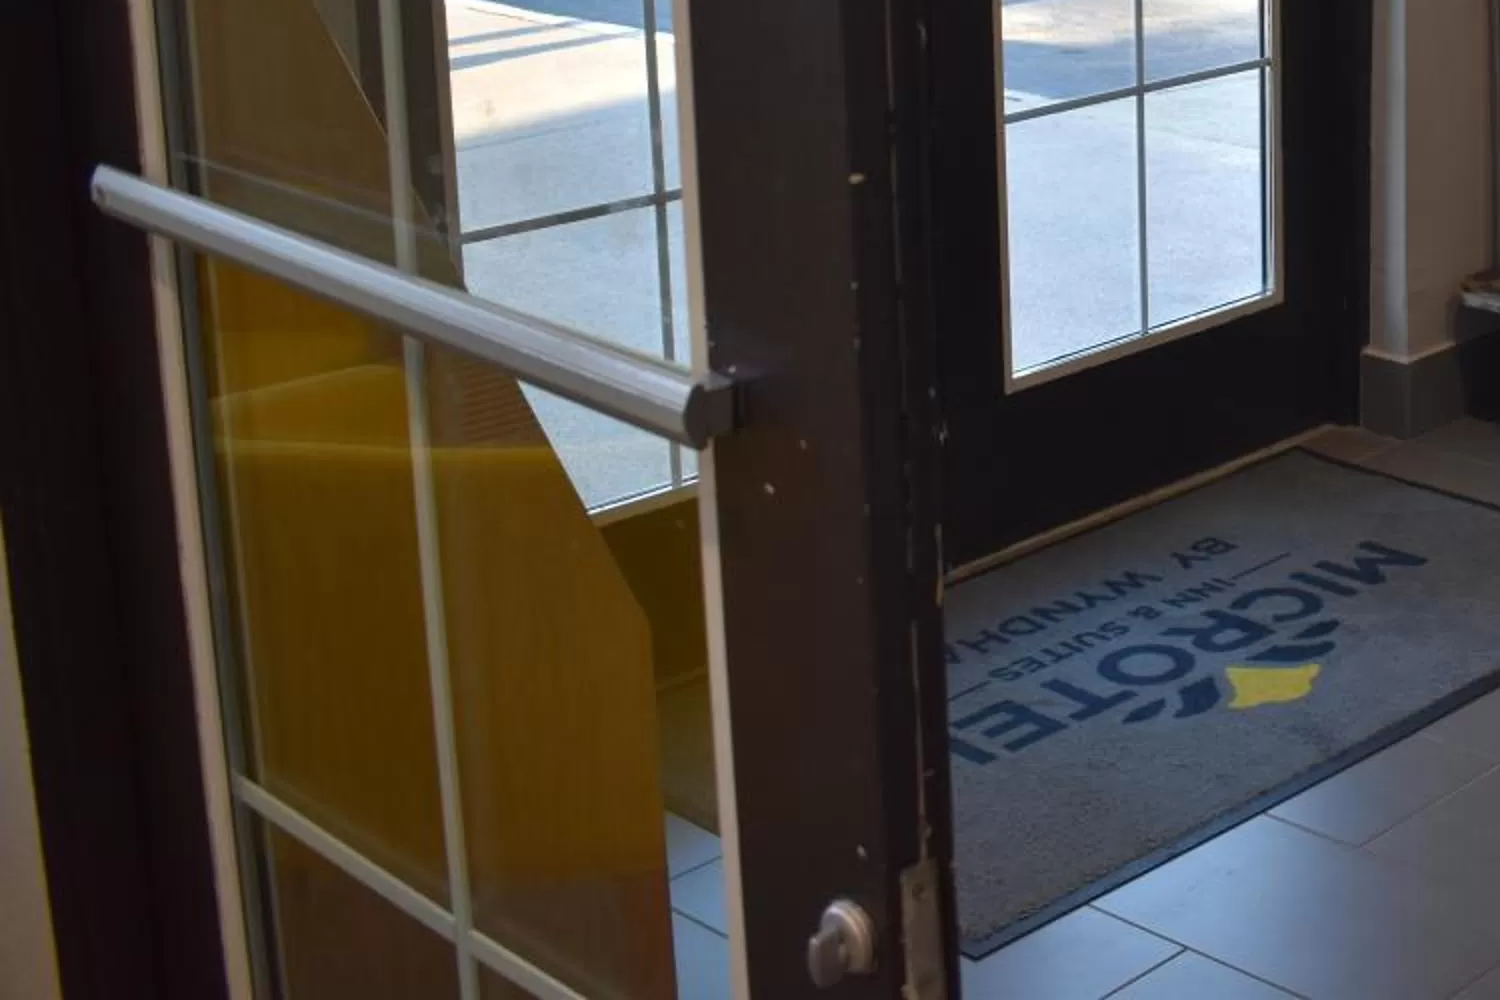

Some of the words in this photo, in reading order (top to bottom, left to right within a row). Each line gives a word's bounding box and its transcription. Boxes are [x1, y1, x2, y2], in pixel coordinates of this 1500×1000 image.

[1170, 537, 1239, 570] BY
[1162, 577, 1233, 611] INN
[1127, 604, 1162, 622] &
[987, 620, 1131, 683] SUITES
